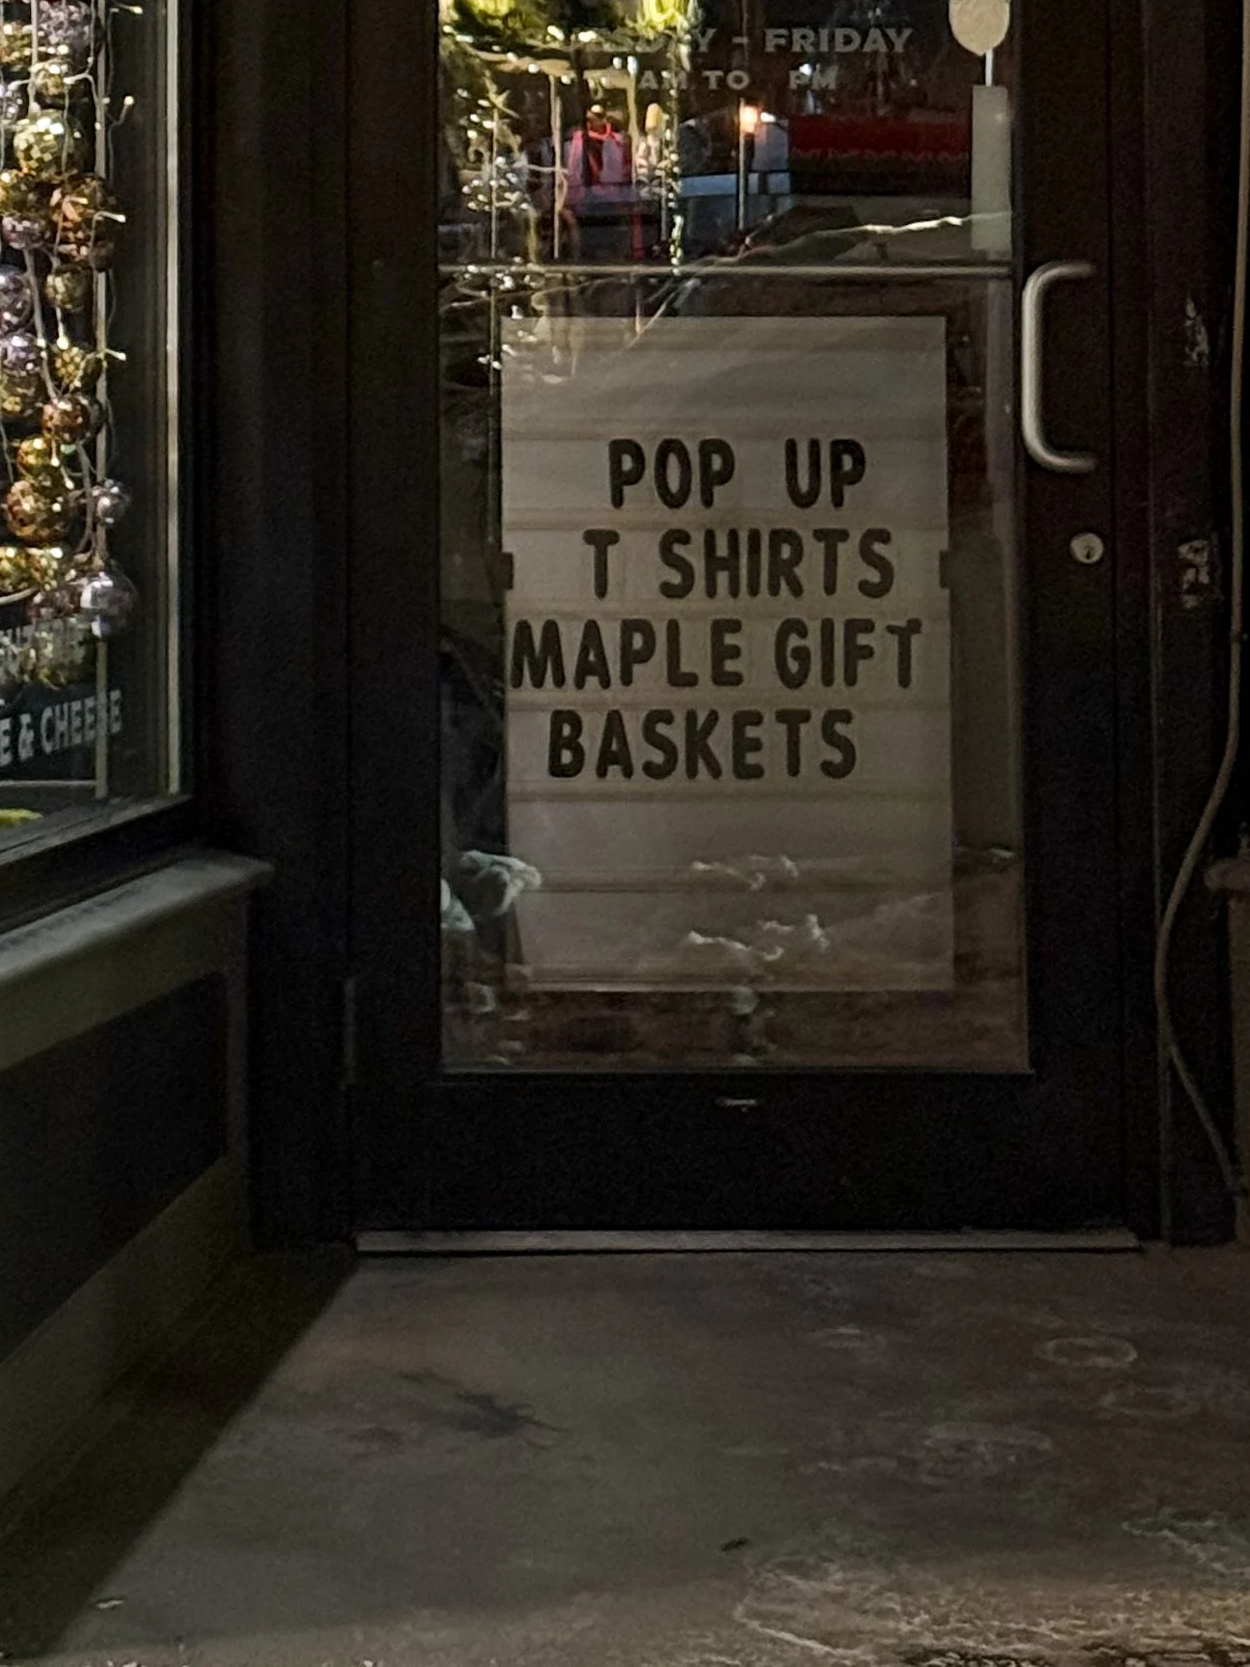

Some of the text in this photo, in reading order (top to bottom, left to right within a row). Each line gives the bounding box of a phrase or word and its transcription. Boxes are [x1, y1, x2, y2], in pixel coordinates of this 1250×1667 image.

[764, 28, 913, 53] FRIDAY
[702, 70, 750, 90] TO
[608, 438, 867, 510] POP UP
[582, 527, 896, 599] T SHIRTS
[510, 618, 923, 690] MAPLE GIFT
[17, 713, 35, 762] &
[547, 708, 858, 780] BASKETS
